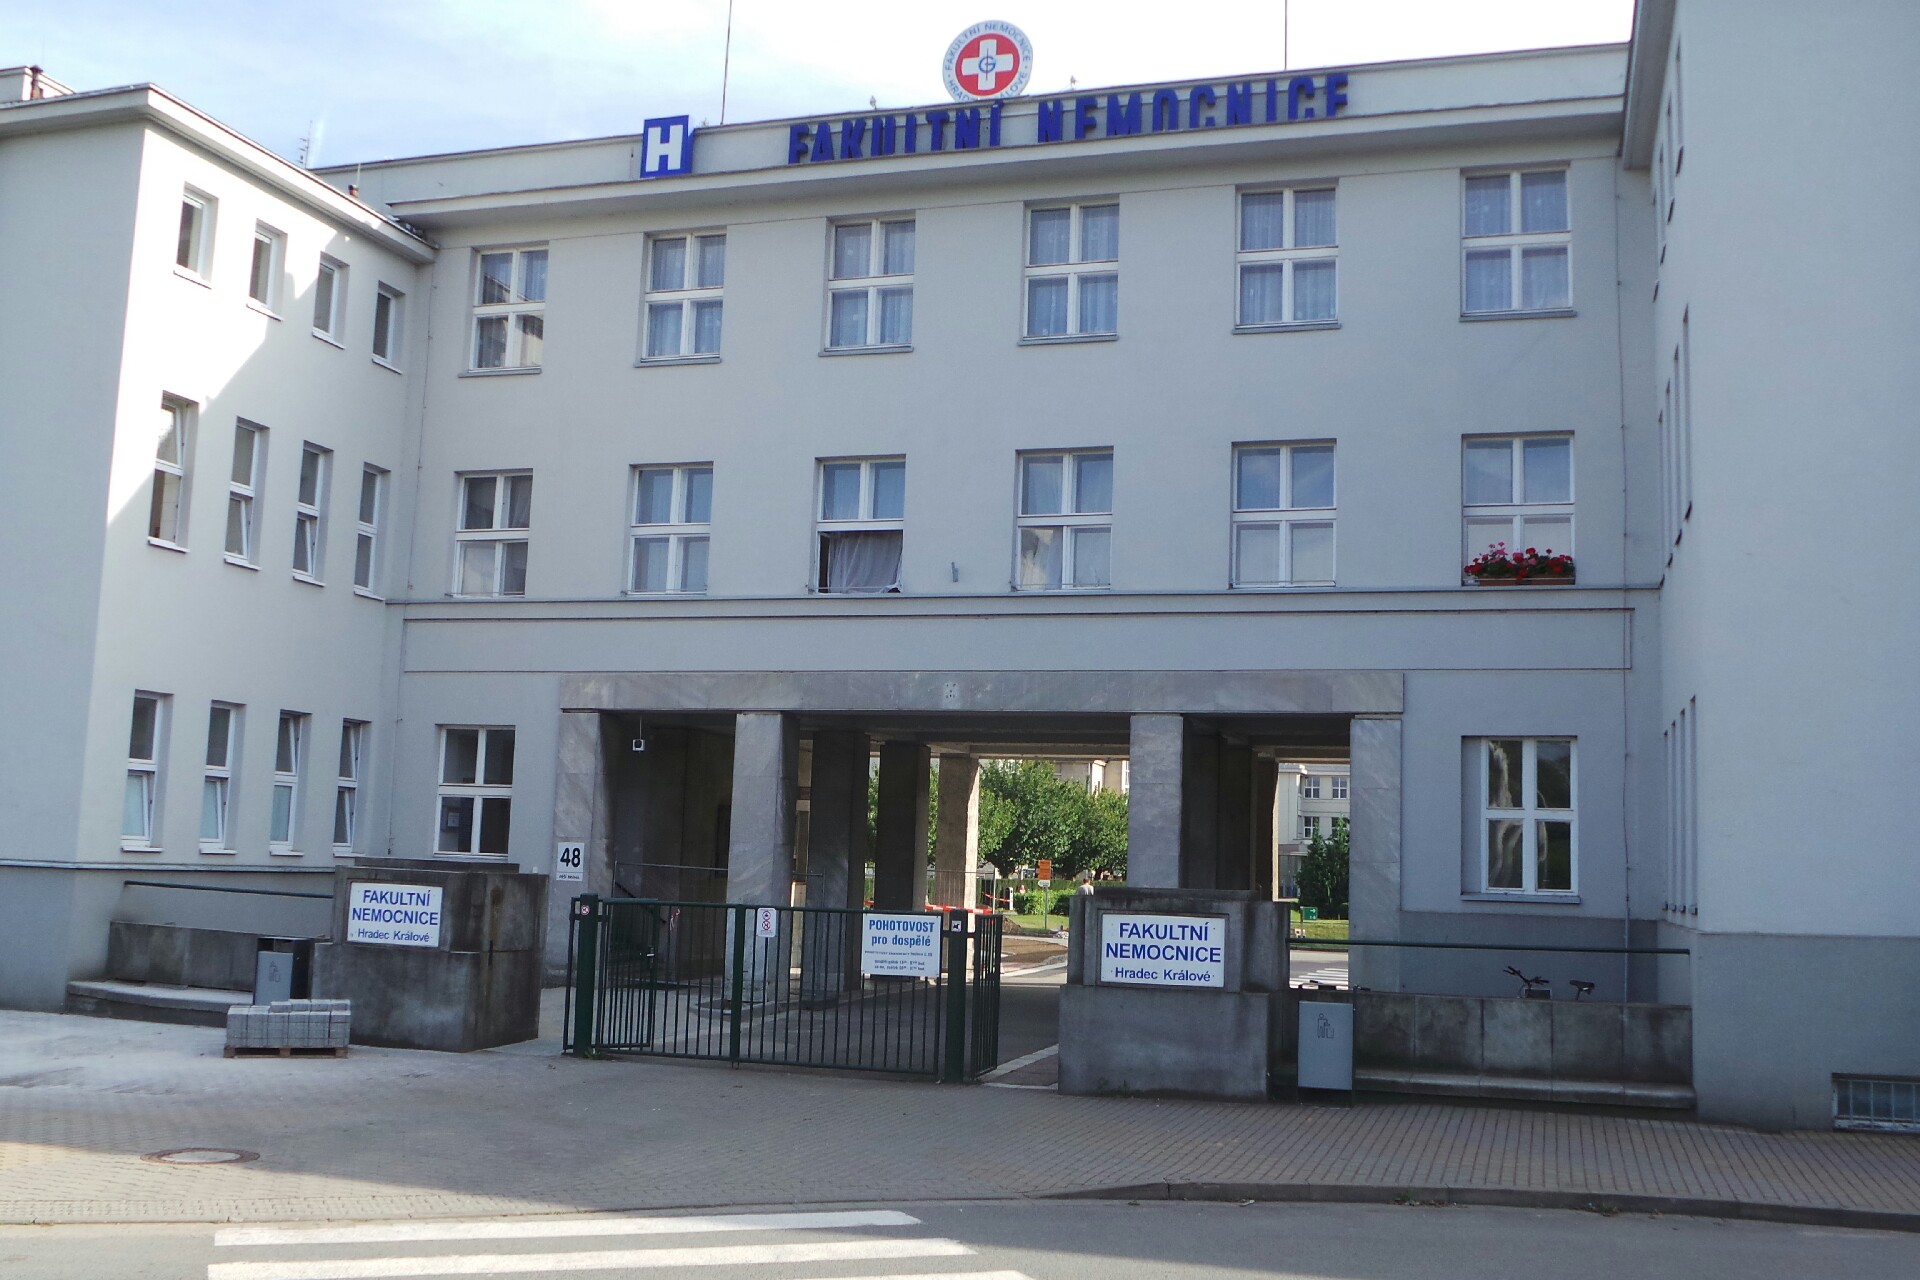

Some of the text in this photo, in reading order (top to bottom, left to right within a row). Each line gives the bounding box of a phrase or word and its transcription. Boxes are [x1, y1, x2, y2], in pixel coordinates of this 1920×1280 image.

[645, 124, 683, 172] H
[560, 847, 581, 868] 48
[363, 889, 431, 907] FAKULTNÍ
[352, 907, 439, 925] NEMOCNICE
[358, 928, 430, 942] Hradec Králové
[869, 919, 935, 933] POHOTOVOST
[1119, 922, 1209, 941] FAKULTNÍ
[871, 934, 931, 948] pro dospělé
[1106, 942, 1221, 963] NEMOCNICE
[1115, 966, 1211, 982] Hradec Králové
